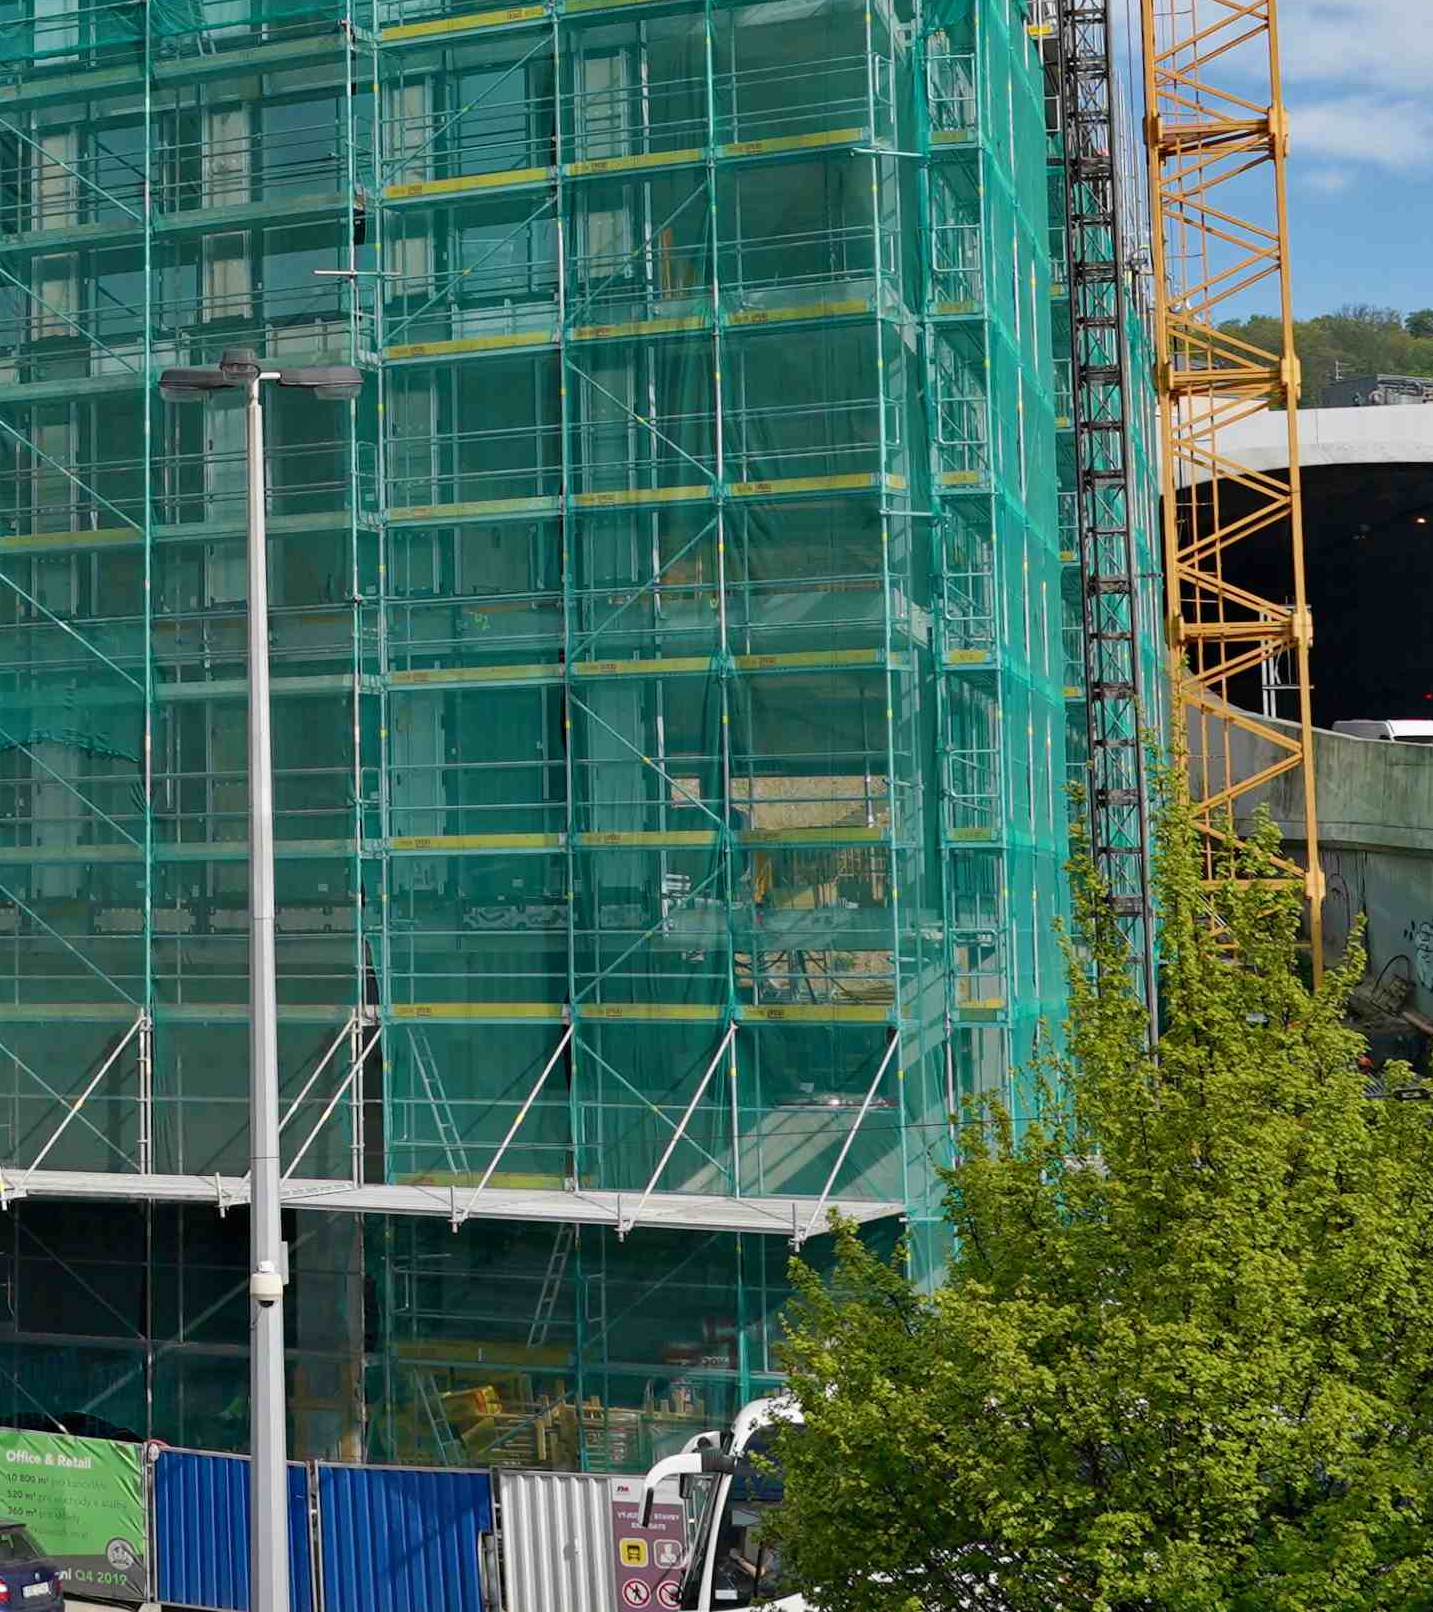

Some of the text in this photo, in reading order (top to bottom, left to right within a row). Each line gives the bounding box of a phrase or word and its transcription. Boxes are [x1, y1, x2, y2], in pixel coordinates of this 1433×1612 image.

[5, 1448, 92, 1469] Office & Retail
[75, 1570, 94, 1583] Q4
[97, 1571, 127, 1585] 2019
